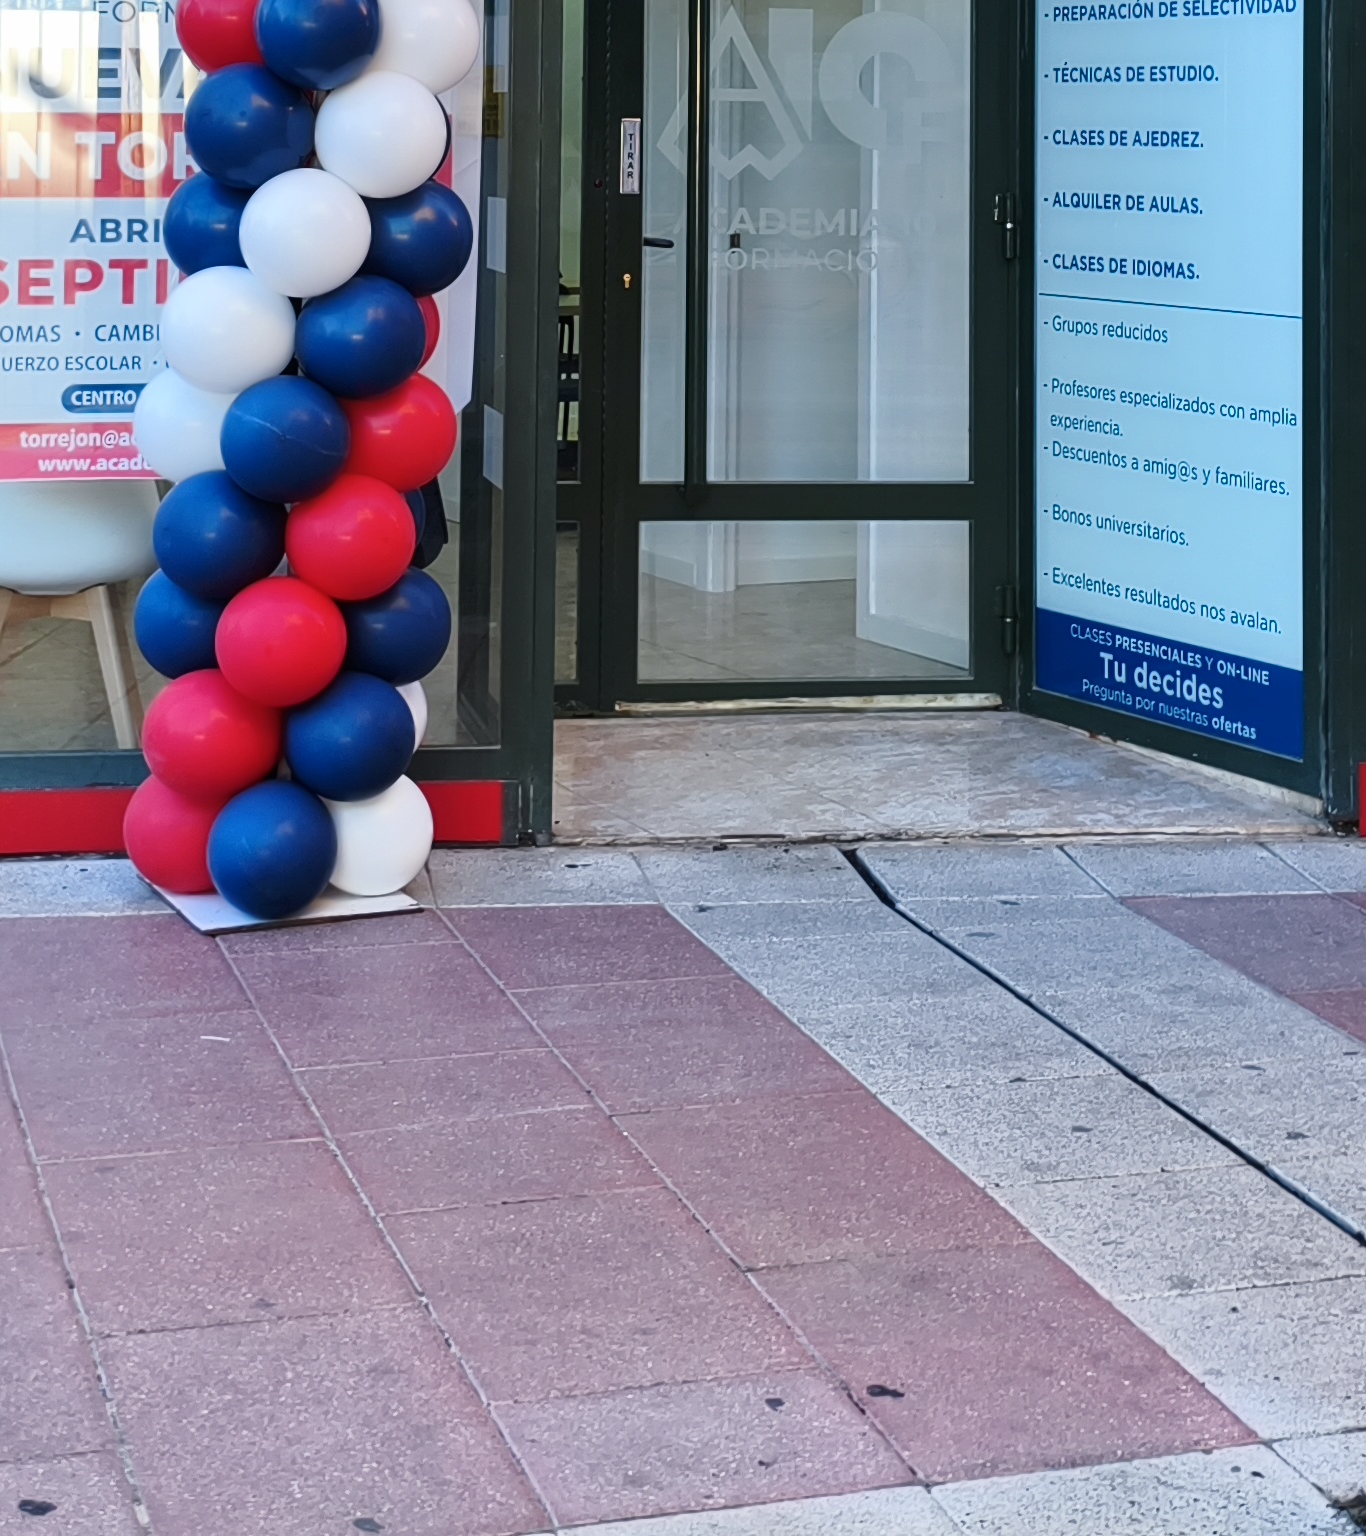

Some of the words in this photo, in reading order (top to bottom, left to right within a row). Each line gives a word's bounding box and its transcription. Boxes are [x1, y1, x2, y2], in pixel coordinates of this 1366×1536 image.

[1158, 0, 1178, 19] DE
[1053, 62, 1122, 83] TÉCNICAS
[1125, 66, 1144, 83] DE
[1149, 65, 1219, 83] ESTUDIO.
[1053, 130, 1106, 147] CLASES
[1109, 130, 1128, 147] DE
[1132, 130, 1204, 149] AJEDREZ.
[1053, 192, 1122, 212] ALQUILER
[1125, 195, 1145, 212] DE
[1148, 196, 1203, 216] AULAS.
[1052, 254, 1105, 274] CLASES
[1108, 257, 1128, 275] DE
[1132, 259, 1200, 280] IDIOMAS.
[1052, 315, 1098, 338] Grupos
[1102, 320, 1168, 344] reducidos
[65, 356, 142, 371] ESCOLAR
[71, 390, 137, 406] CENTRO
[1051, 378, 1116, 403] Profesores
[1119, 387, 1215, 417] especializados
[1219, 402, 1245, 419] con
[1249, 407, 1297, 428] amplia
[1050, 412, 1124, 439] experiencia.
[1052, 440, 1127, 470] Descuentos
[1131, 456, 1139, 471] a
[1142, 457, 1198, 483] amig@s
[1202, 468, 1211, 486] y
[1215, 465, 1290, 497] familiares.
[1052, 504, 1092, 527] Bonos
[1095, 510, 1189, 546] universitarios.
[1052, 567, 1121, 600] Excelentes
[1124, 583, 1196, 616] resultados
[1200, 601, 1225, 622] nos
[1229, 604, 1282, 634] avalan.
[1070, 623, 1113, 647] CLASES
[1115, 633, 1202, 668] PRESENCIALES
[1204, 656, 1214, 671] Y
[1216, 659, 1269, 685] ON-LINE
[1099, 651, 1126, 684] Tu
[1134, 662, 1224, 710] decides
[1082, 678, 1133, 707] Pregunta
[1135, 694, 1155, 715] por
[1158, 701, 1209, 727] nuestras
[1211, 714, 1257, 740] ofertas
